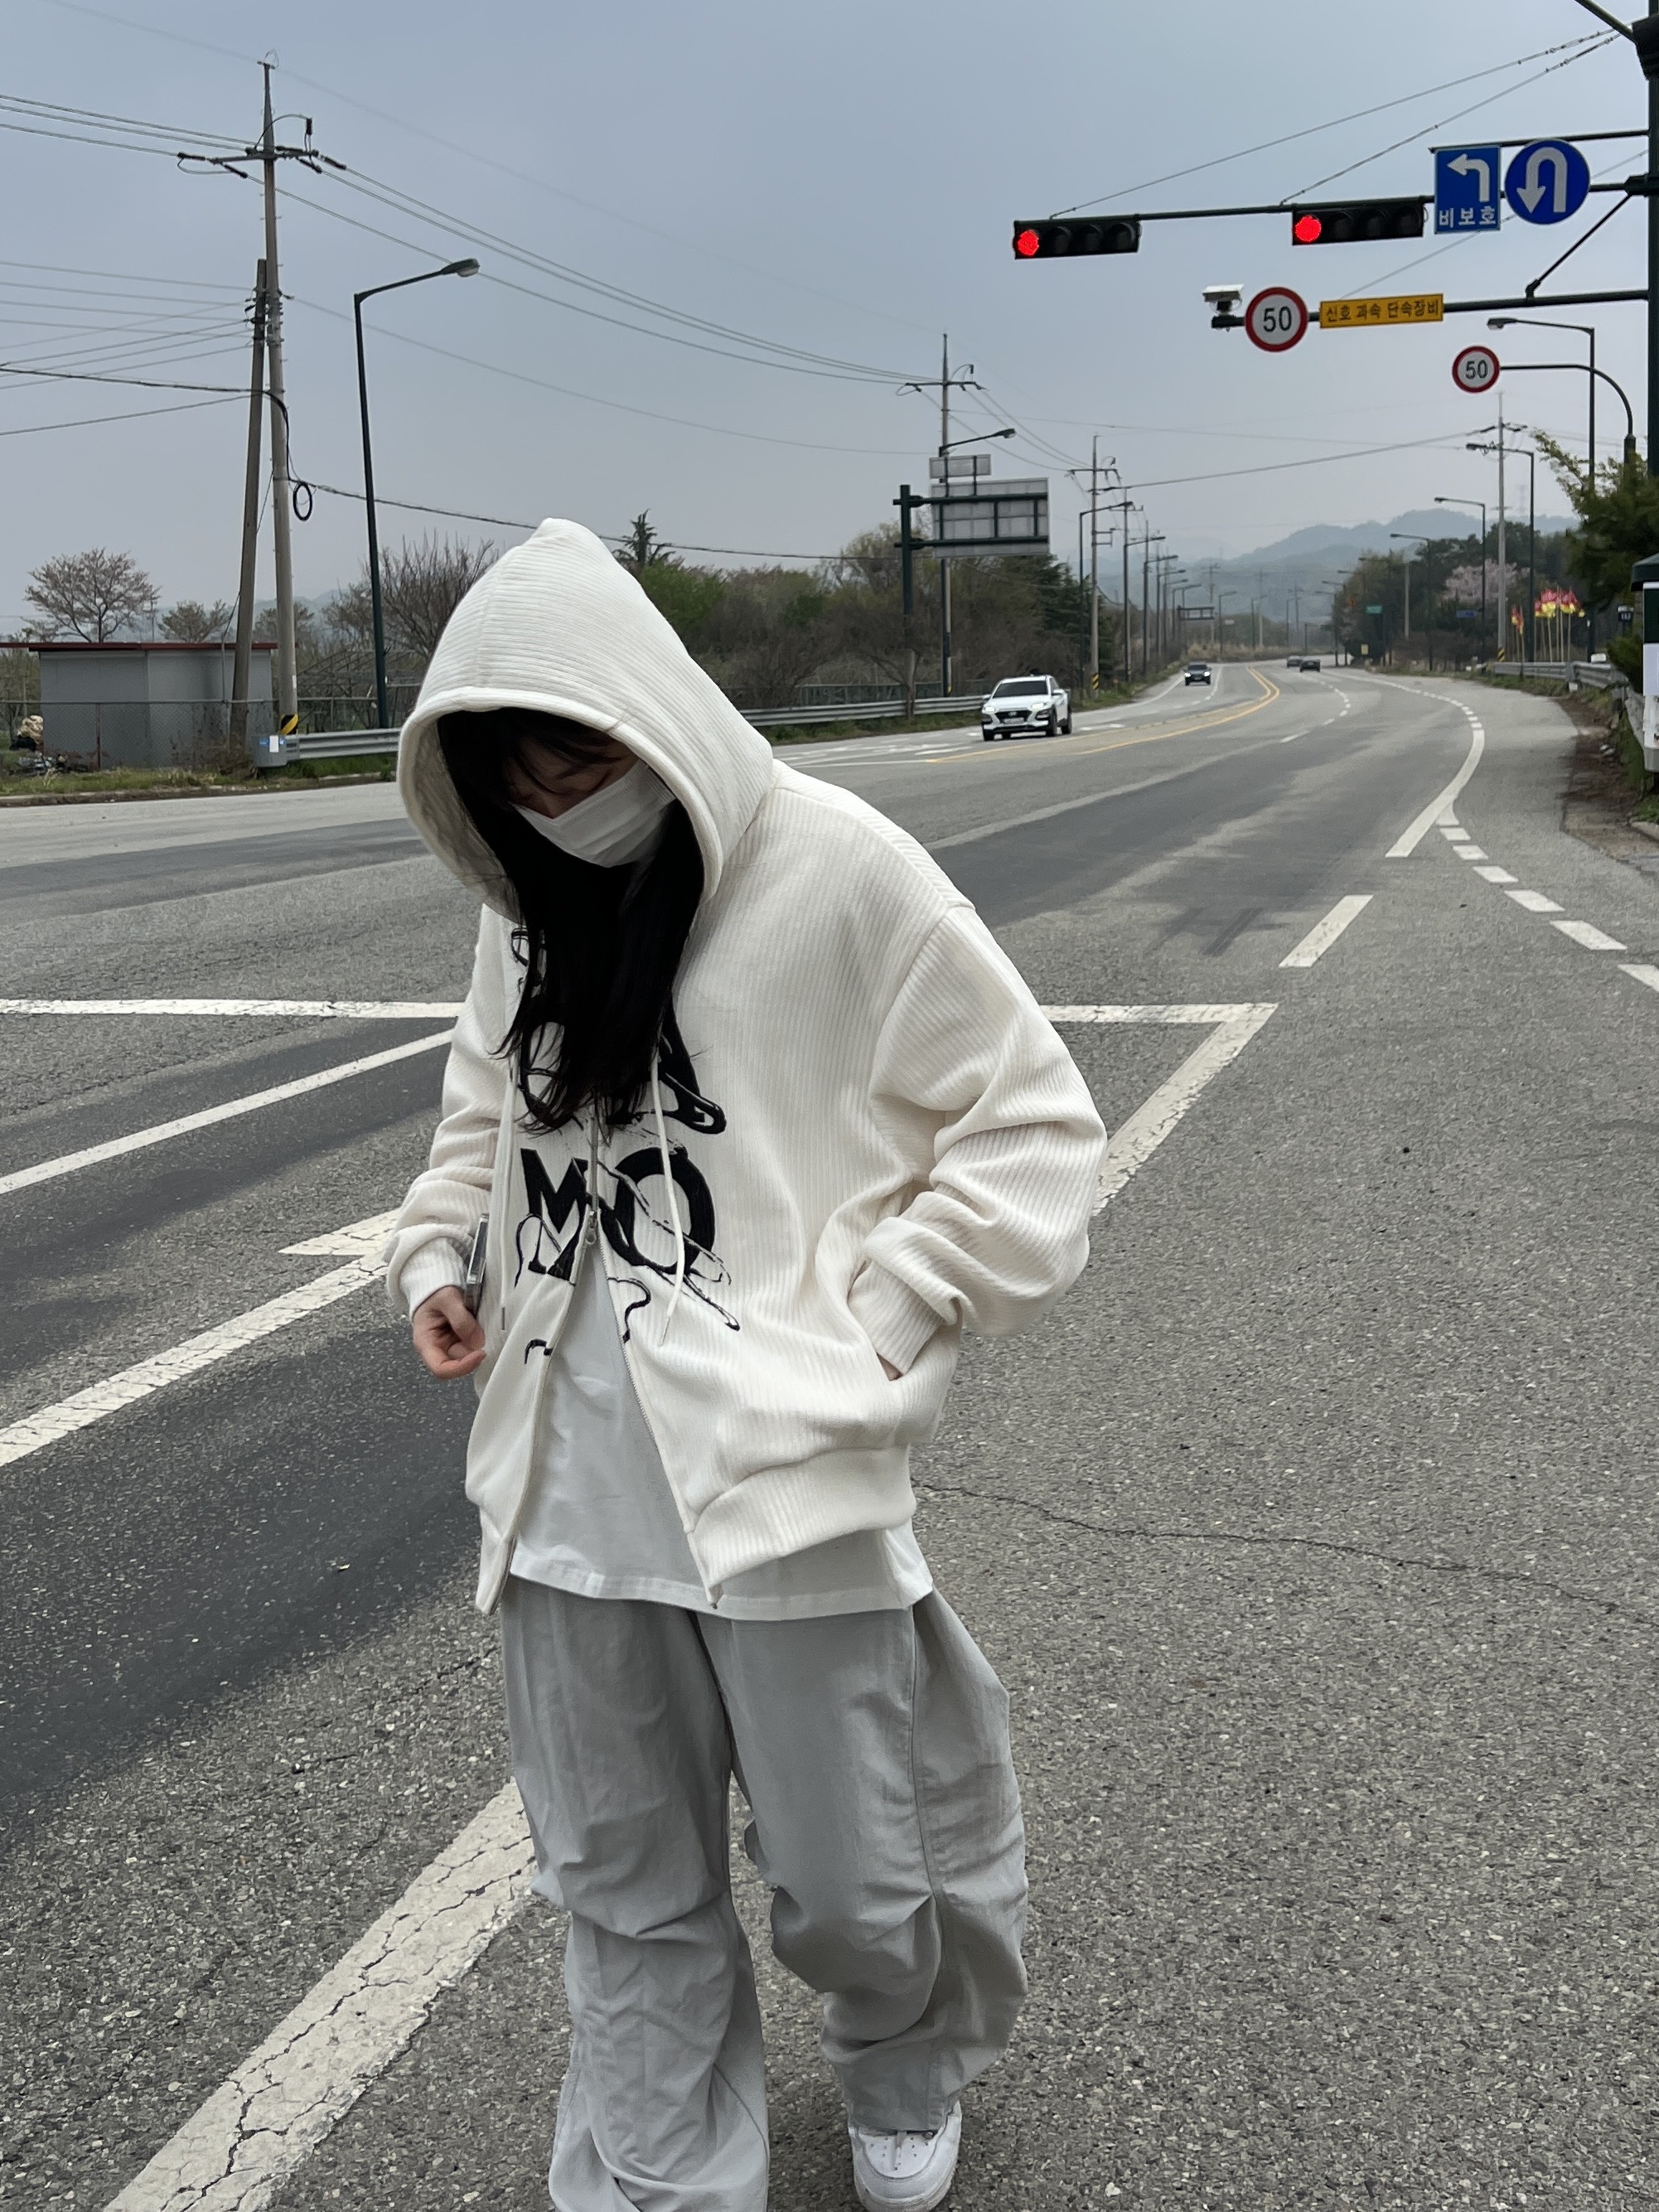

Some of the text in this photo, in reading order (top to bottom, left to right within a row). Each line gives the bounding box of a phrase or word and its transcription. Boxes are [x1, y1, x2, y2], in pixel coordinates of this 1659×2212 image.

[1439, 206, 1496, 228] 비보호
[1263, 306, 1292, 332] 50
[1328, 299, 1439, 322] 신호 과속 단속장비
[1465, 360, 1488, 380] 50
